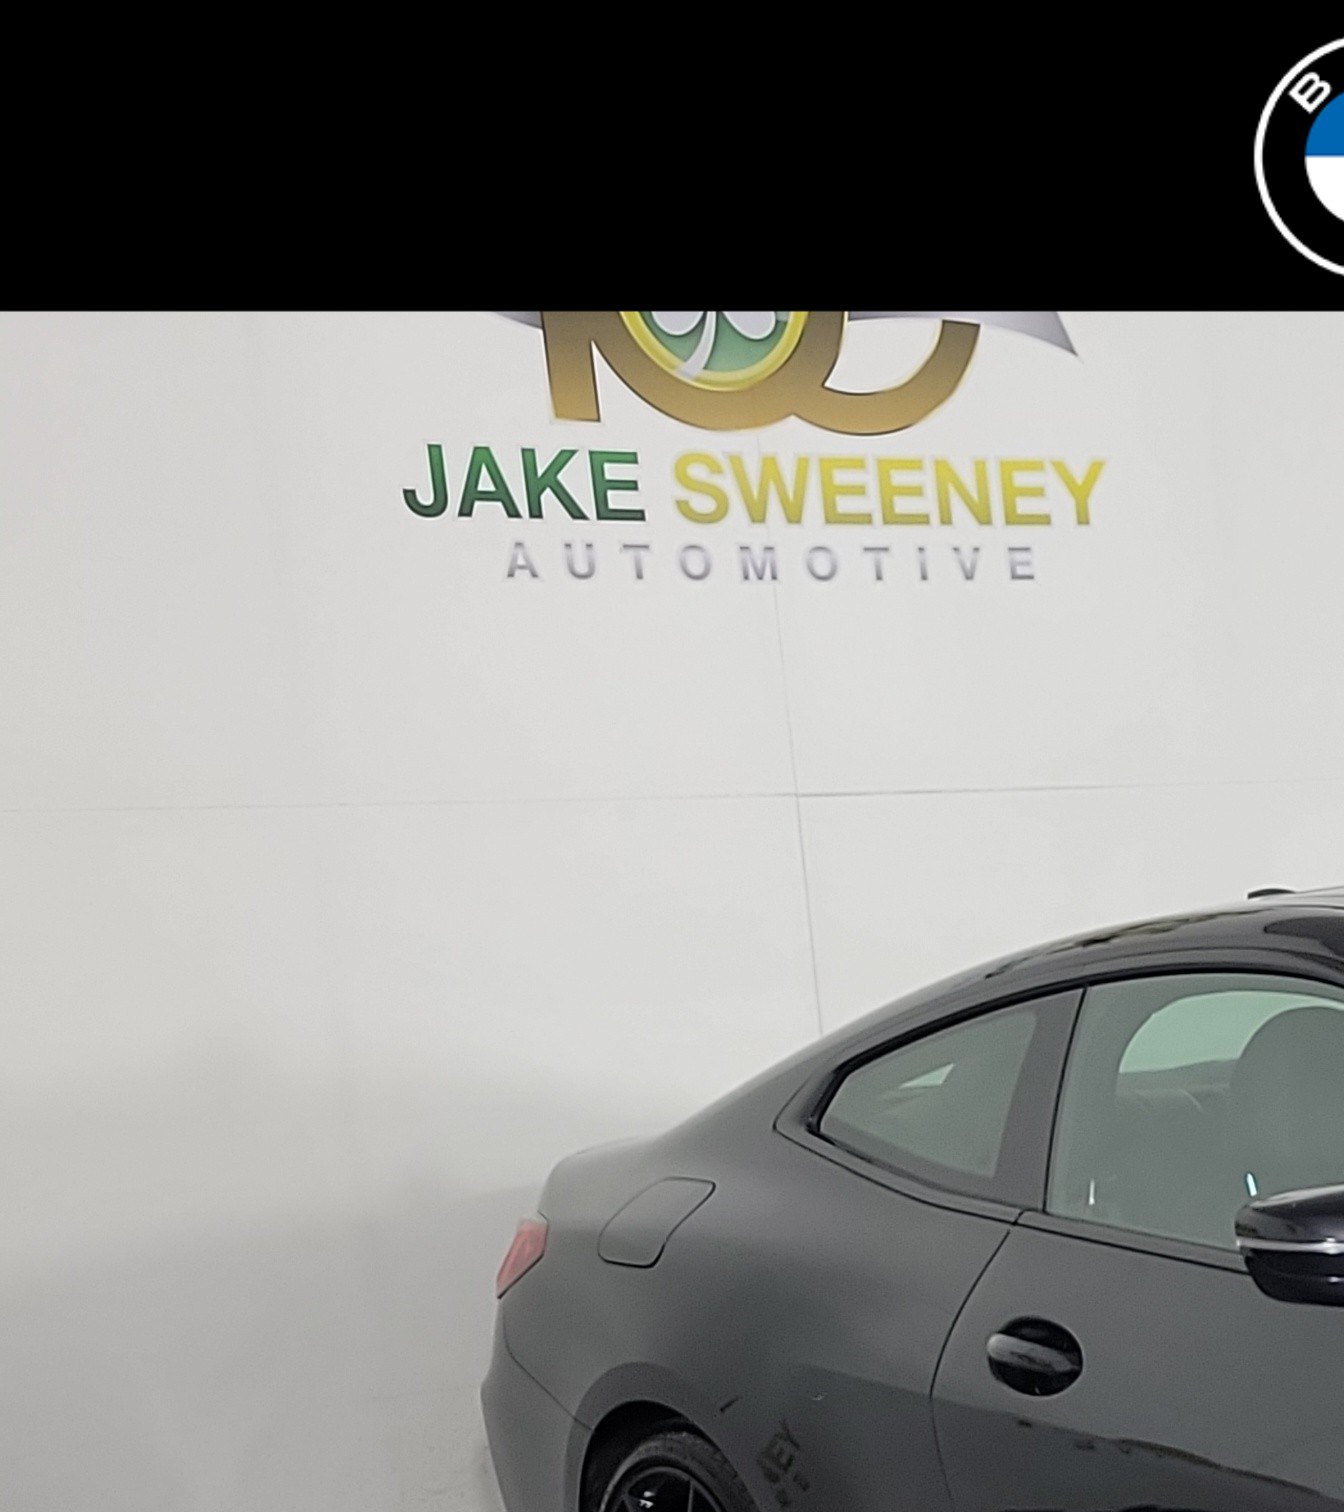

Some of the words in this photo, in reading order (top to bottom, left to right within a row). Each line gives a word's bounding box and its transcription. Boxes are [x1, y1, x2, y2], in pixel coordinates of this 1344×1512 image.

[402, 443, 647, 522] JAKE
[673, 451, 1106, 527] SWEENEY
[506, 542, 1035, 582] AUTOMOTIVE
